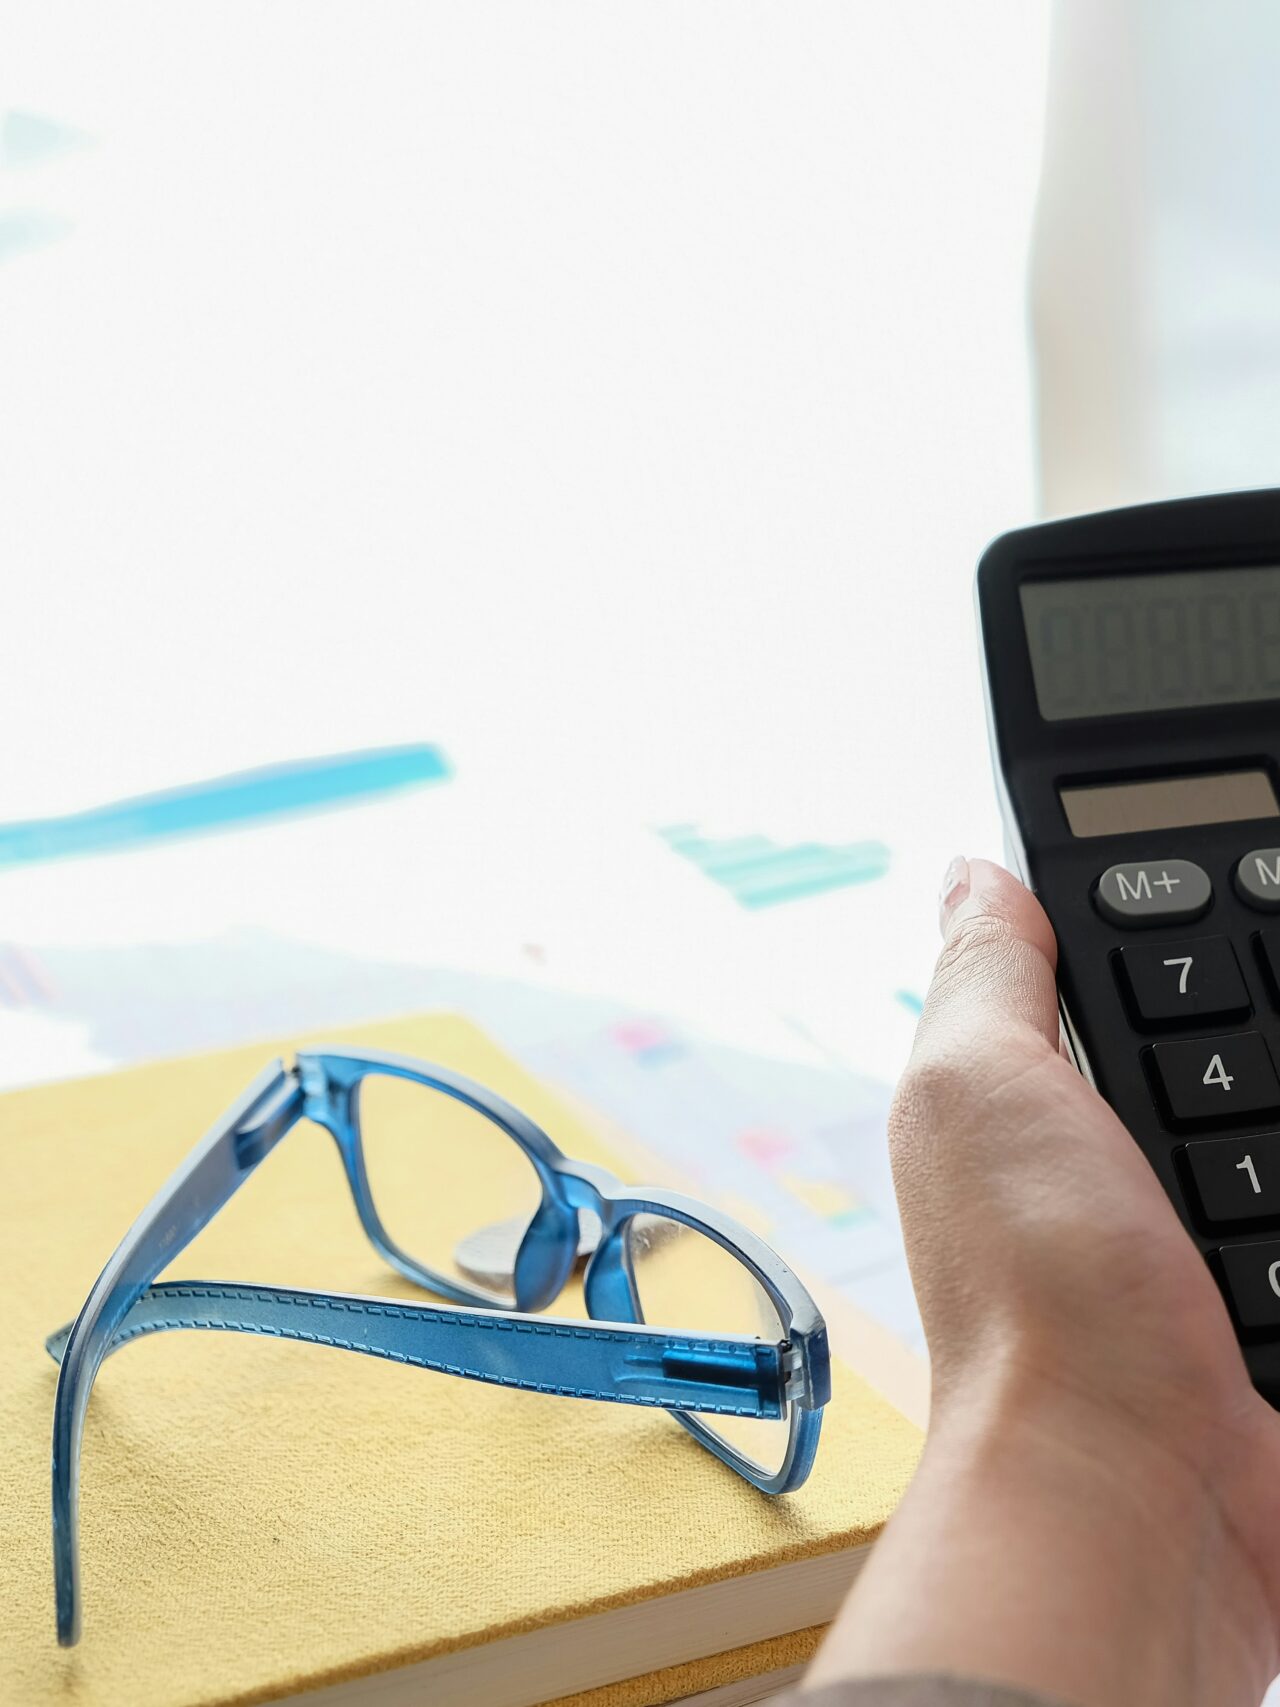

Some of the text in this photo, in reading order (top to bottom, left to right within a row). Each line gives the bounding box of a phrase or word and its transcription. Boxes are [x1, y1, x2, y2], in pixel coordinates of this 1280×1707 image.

[1115, 871, 1181, 901] M+
[1163, 956, 1194, 994] 7
[1202, 1054, 1234, 1091] 4
[1235, 1154, 1262, 1194] 1
